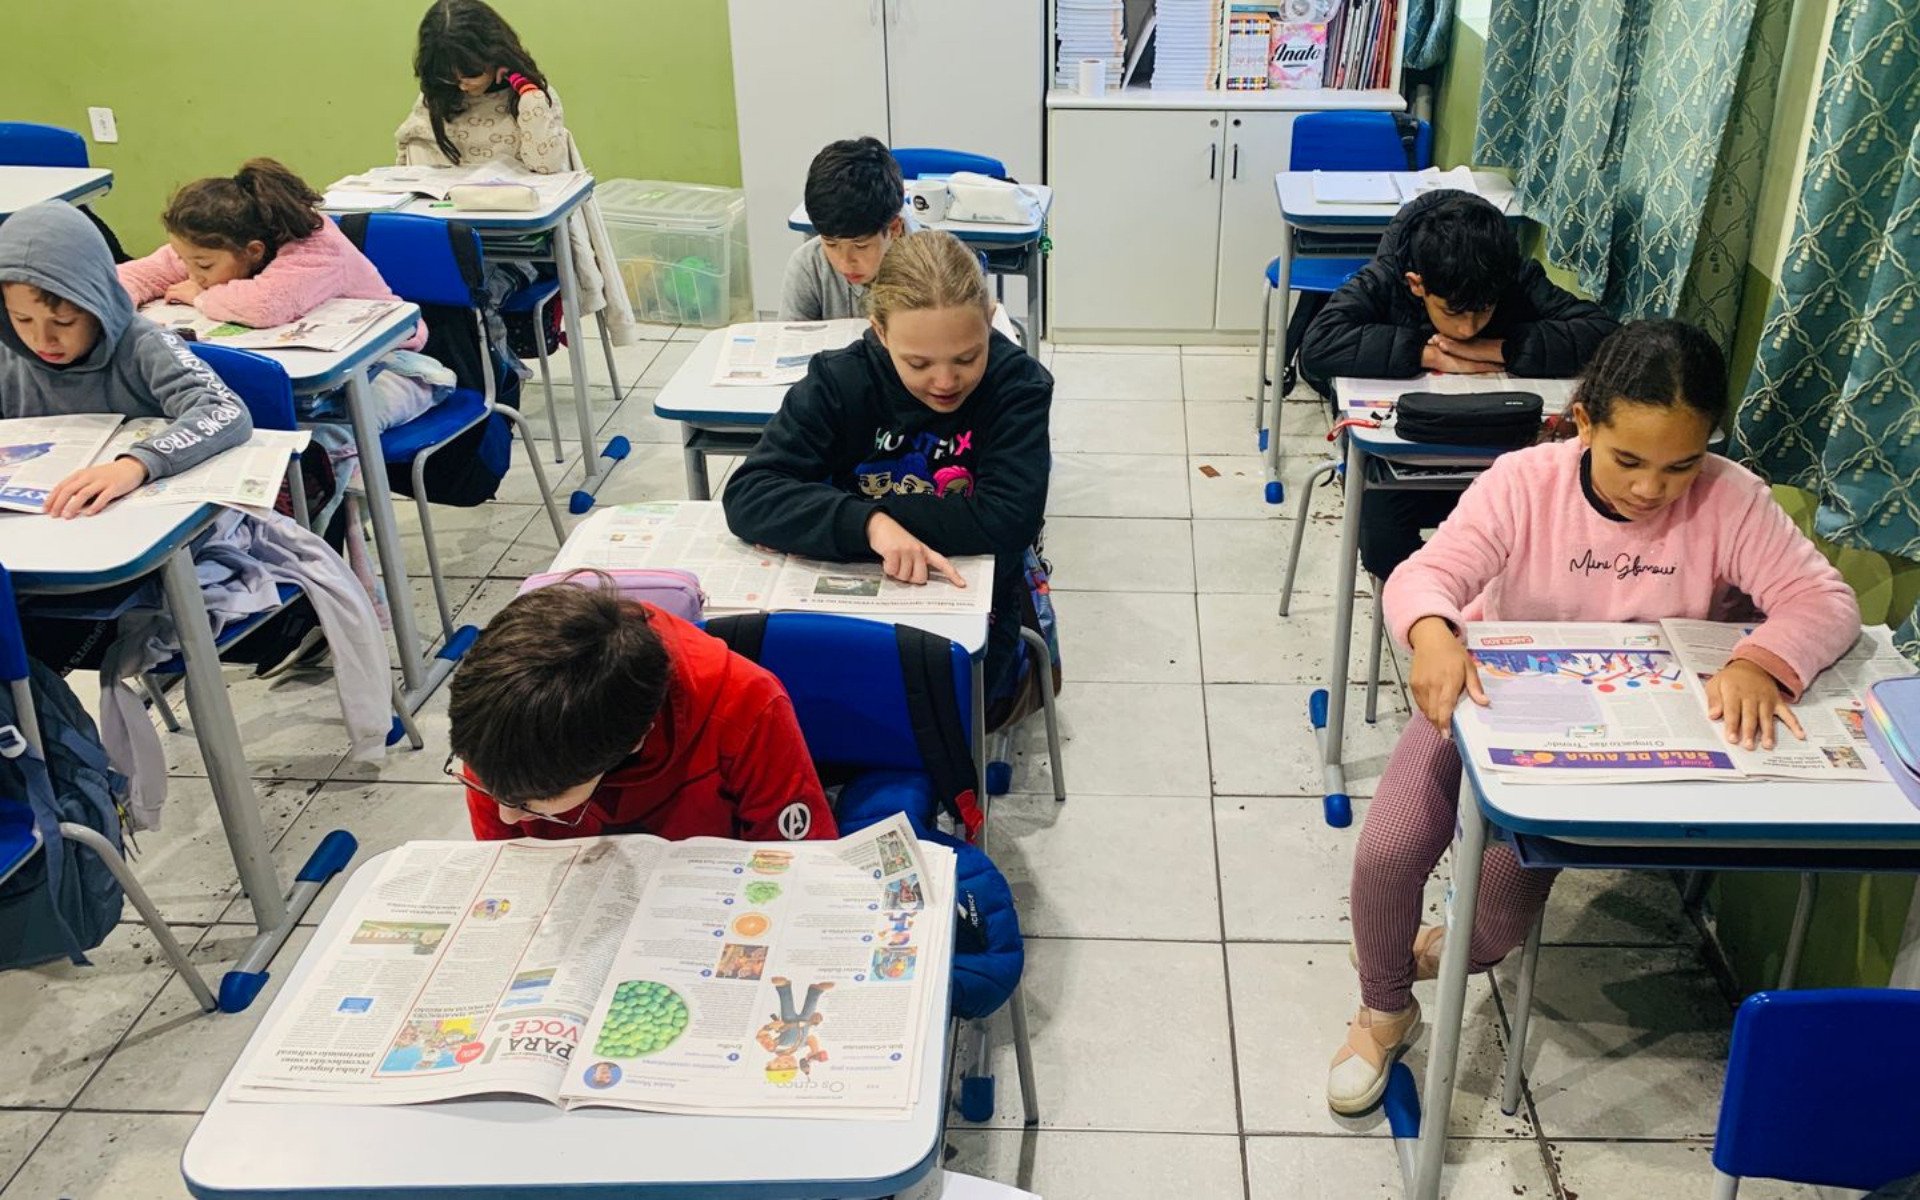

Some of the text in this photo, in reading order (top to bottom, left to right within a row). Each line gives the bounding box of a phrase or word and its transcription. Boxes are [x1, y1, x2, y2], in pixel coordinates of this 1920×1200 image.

[1564, 752, 1710, 762] SALA DE AULA
[511, 1020, 578, 1044] VOCÊ
[509, 1037, 575, 1061] PARA
